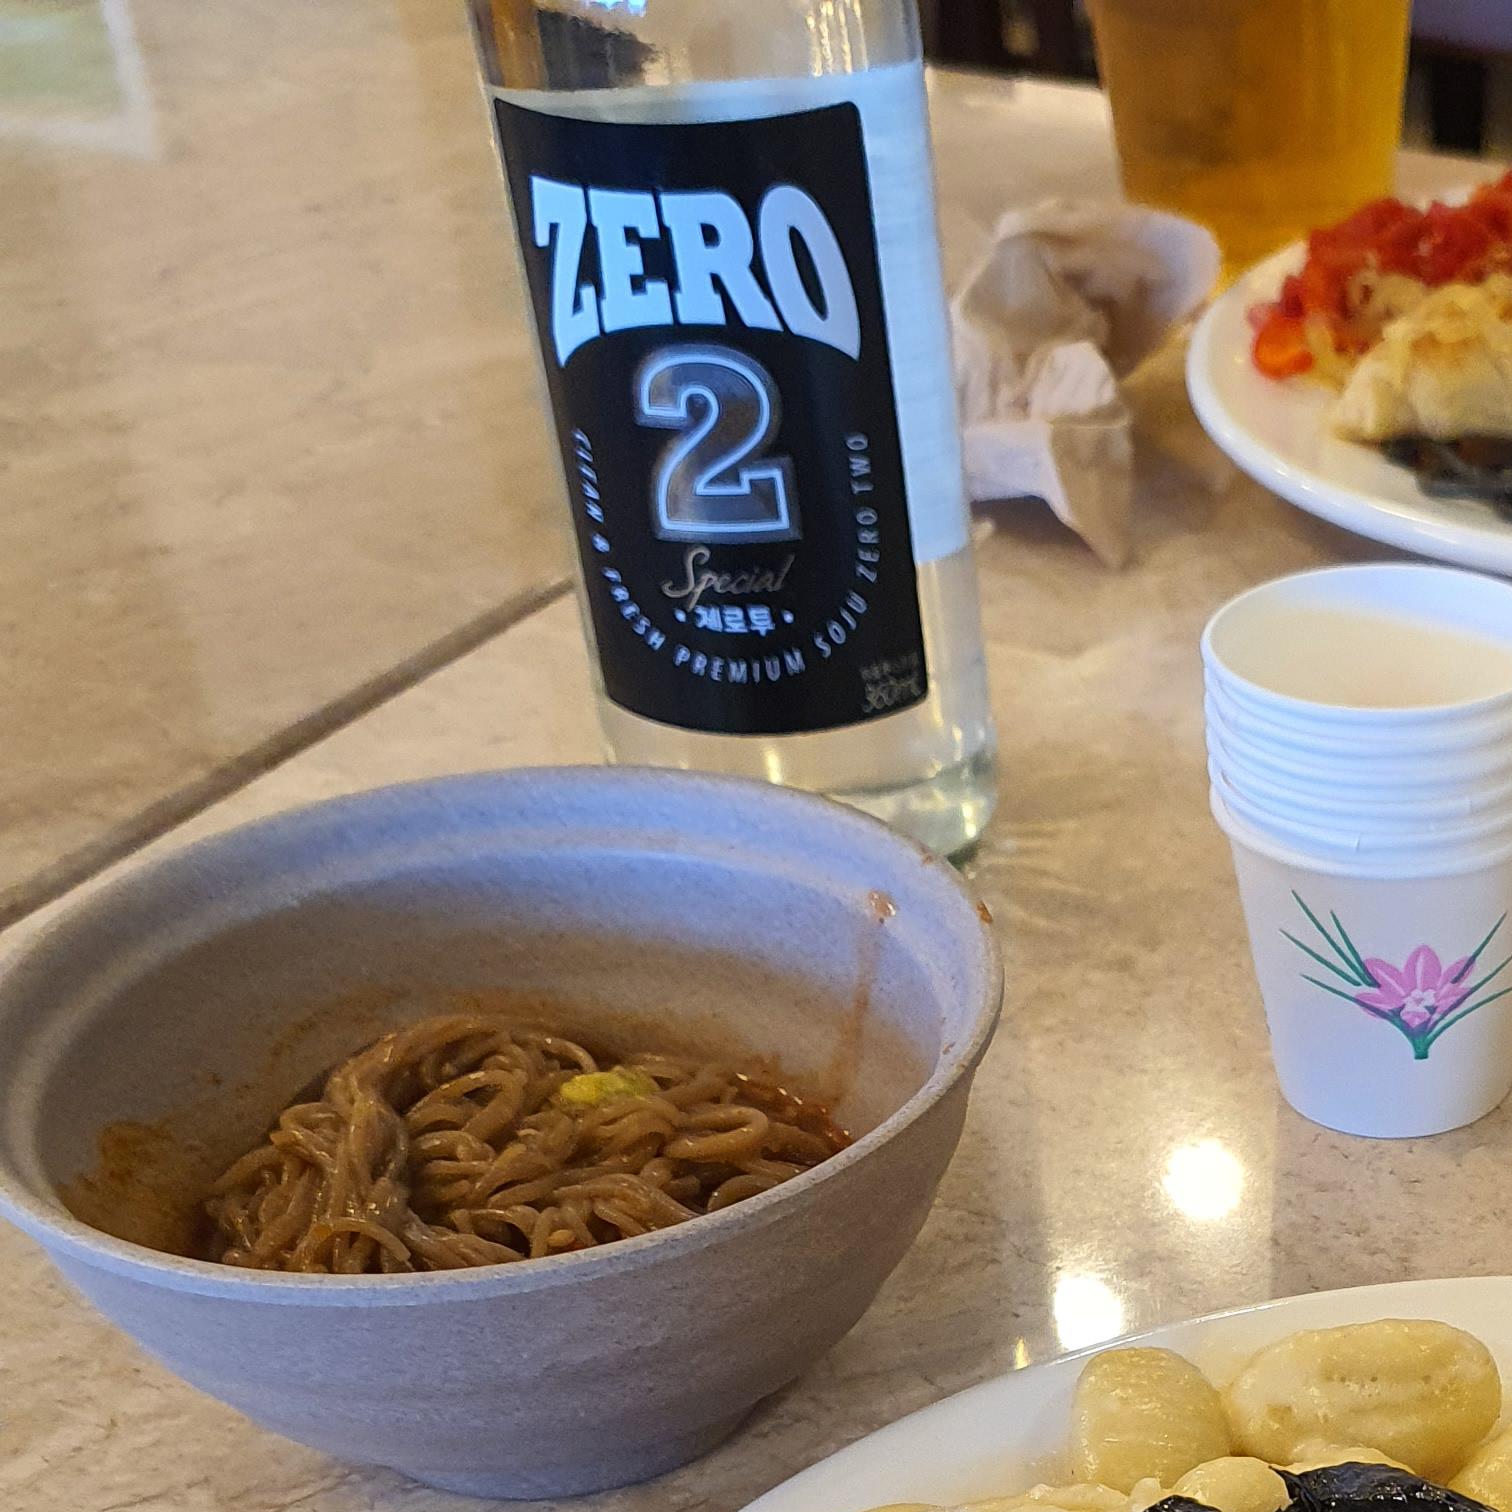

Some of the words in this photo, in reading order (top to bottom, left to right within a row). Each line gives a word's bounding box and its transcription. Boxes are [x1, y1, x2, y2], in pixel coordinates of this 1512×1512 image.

[530, 174, 862, 368] ZERO
[635, 344, 800, 542] 2
[845, 431, 874, 496] TWO
[661, 546, 796, 612] Special
[855, 506, 880, 584] ZERO
[602, 565, 667, 651] FRESH
[813, 589, 869, 659] SOJU
[672, 644, 806, 686] PREMIUM
